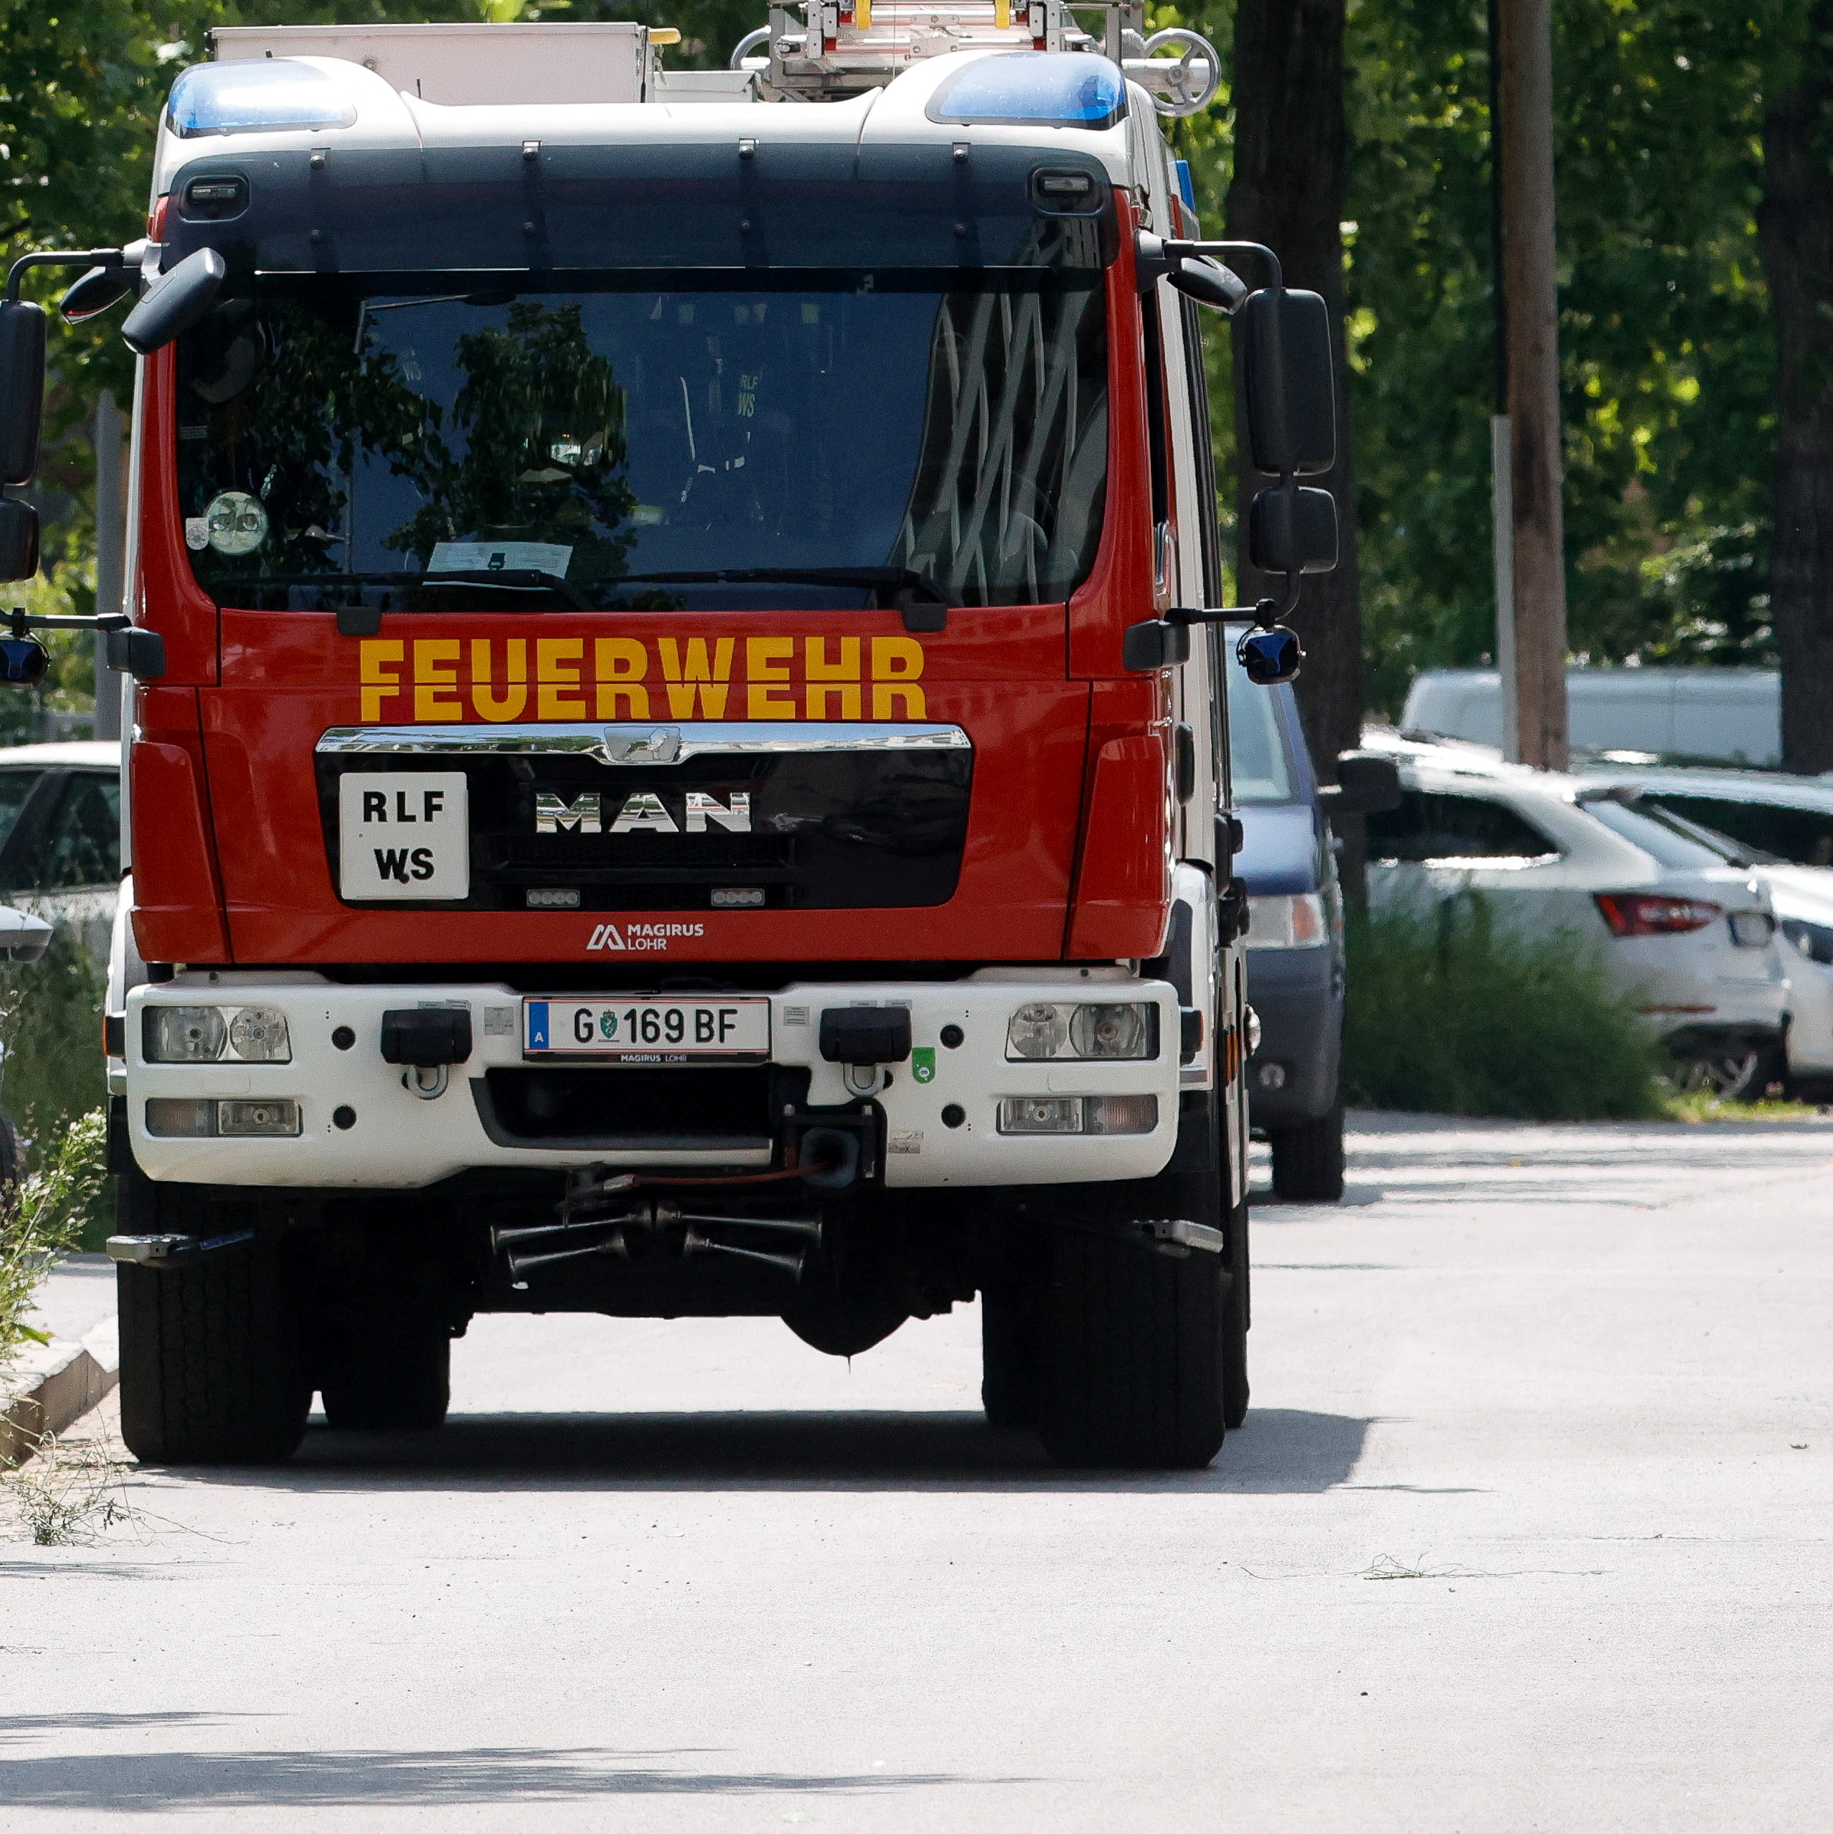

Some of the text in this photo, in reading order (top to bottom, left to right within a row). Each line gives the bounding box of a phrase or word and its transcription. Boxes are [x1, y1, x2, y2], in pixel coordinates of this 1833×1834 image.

[359, 636, 927, 722] FEUERWEHR
[363, 791, 444, 822] RLF
[535, 792, 751, 833] MAN
[374, 847, 435, 884] WS
[627, 923, 704, 936] MAGIRUS
[627, 938, 667, 950] LOHR
[534, 1031, 545, 1043] A
[574, 1007, 738, 1044] G 169 BF
[620, 1054, 661, 1062] MAGIRUS
